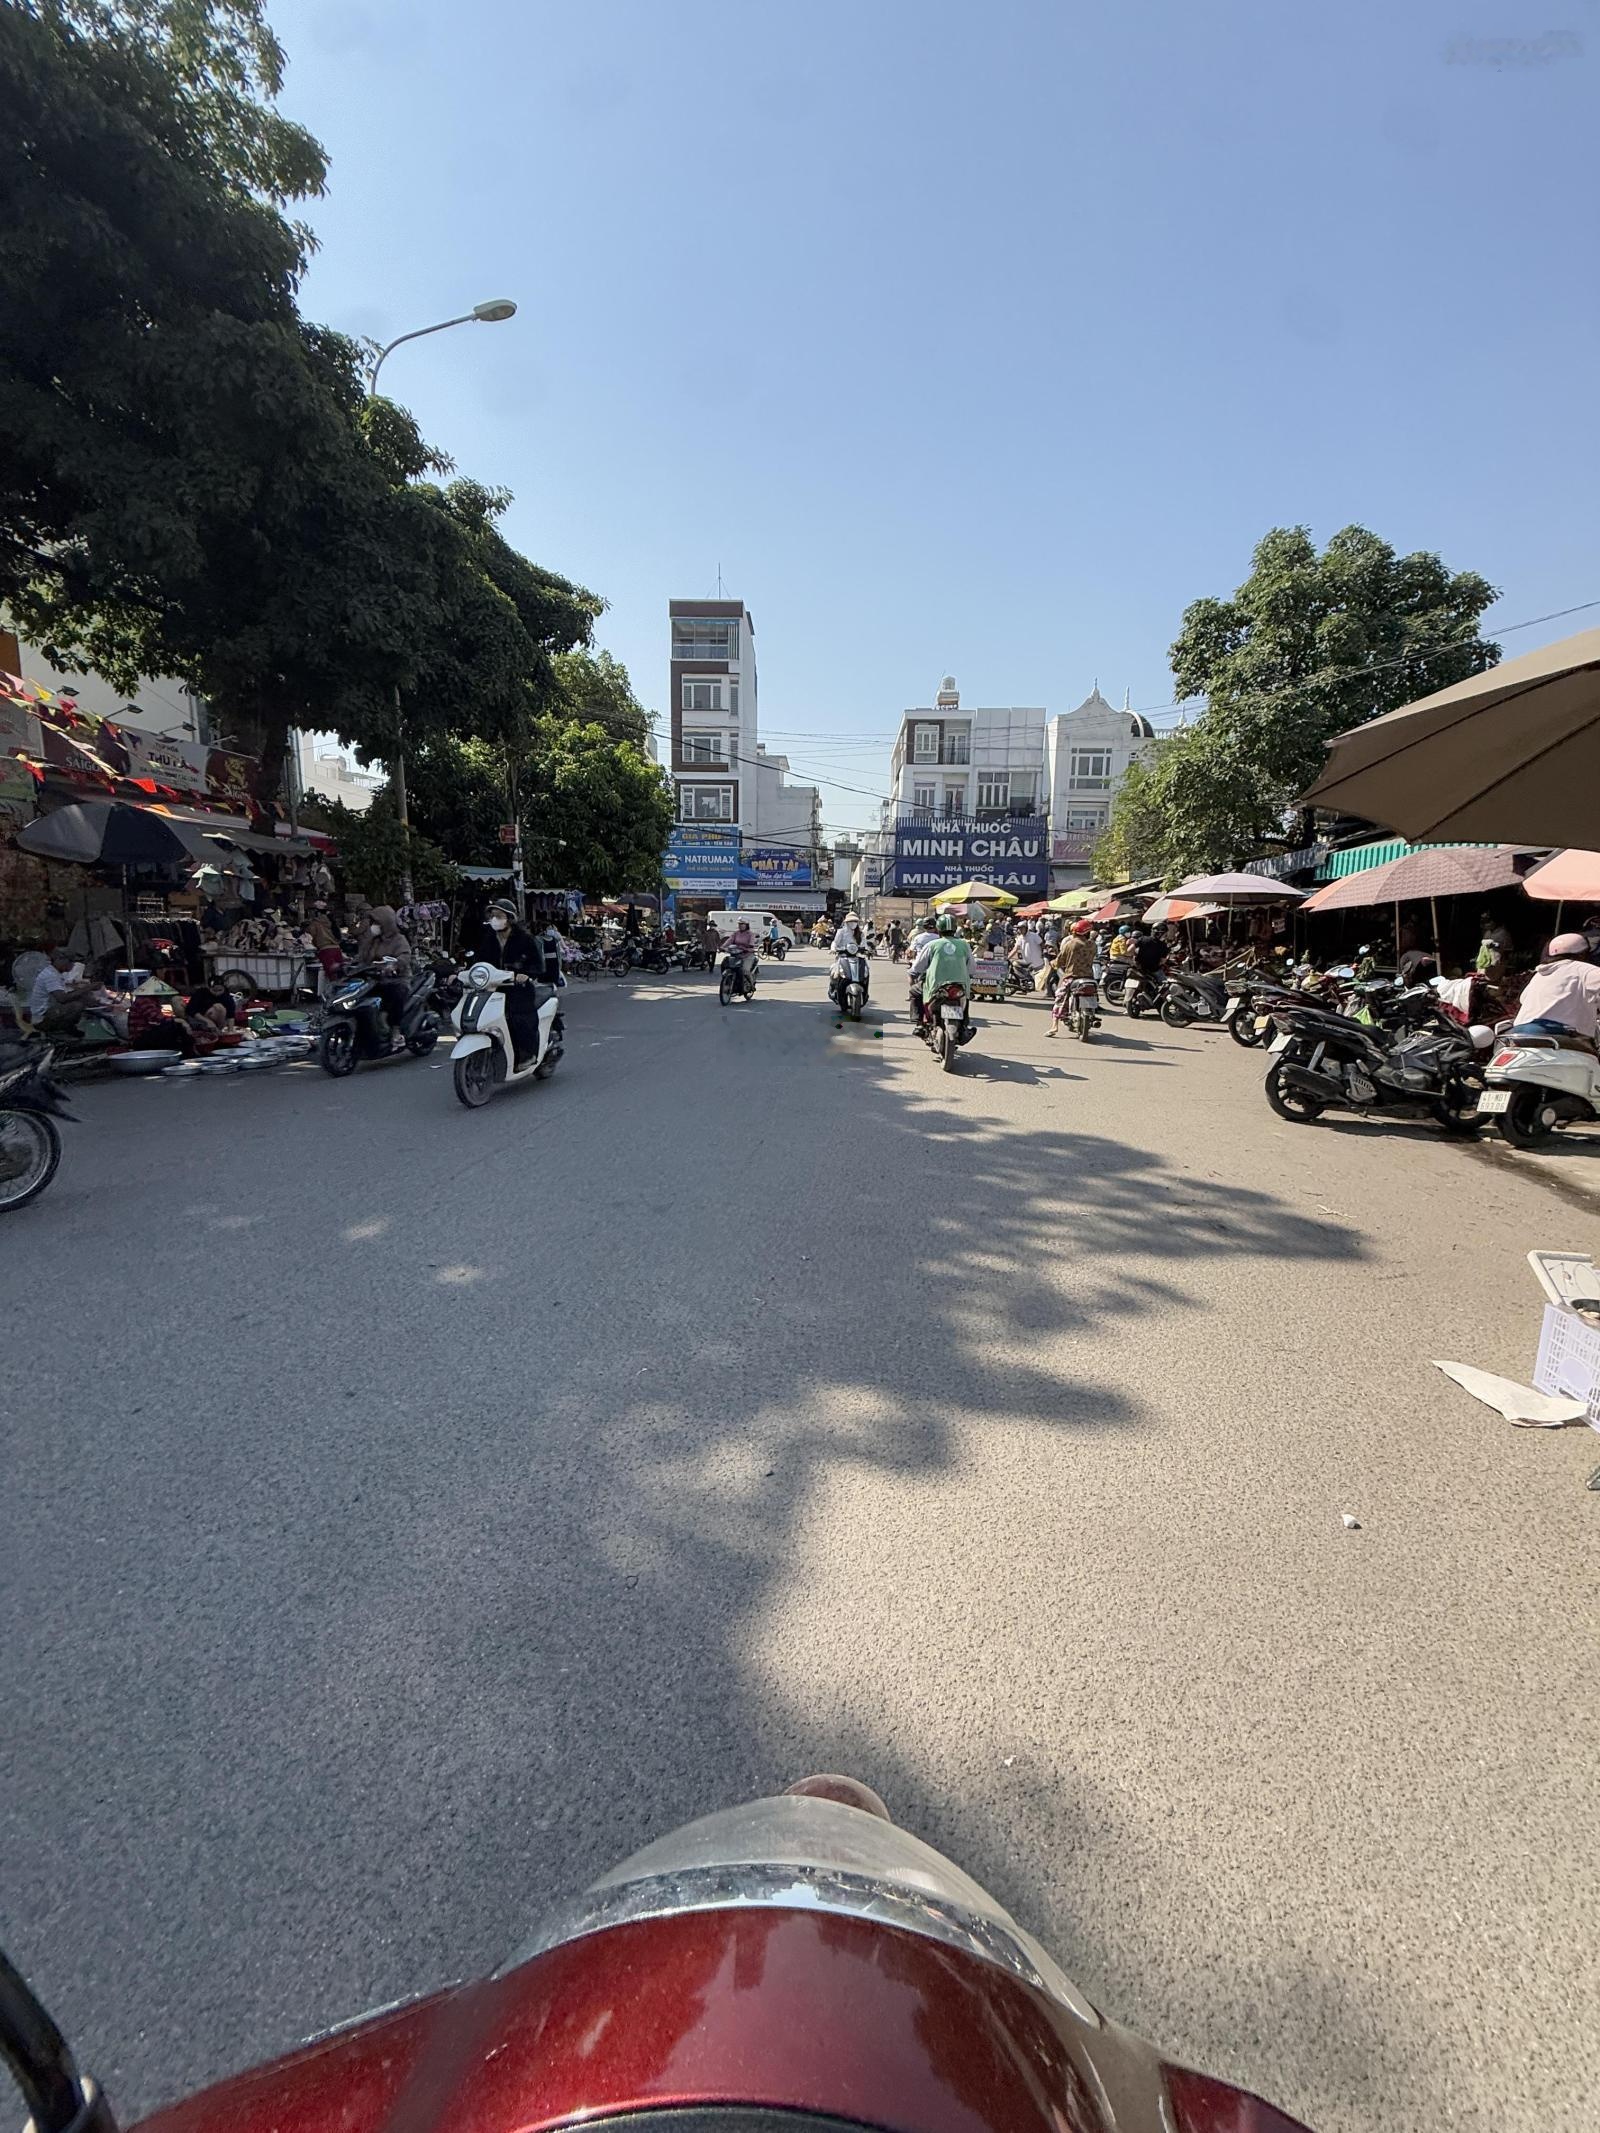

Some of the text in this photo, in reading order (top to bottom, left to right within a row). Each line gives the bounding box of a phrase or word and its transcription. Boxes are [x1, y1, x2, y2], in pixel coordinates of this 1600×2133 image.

[965, 818, 1012, 833] THUỐC
[902, 839, 963, 857] MINH
[971, 836, 1039, 857] CHÂU
[684, 855, 735, 864] NATRUMAX
[751, 859, 799, 871] PHÁT TÀI
[944, 863, 994, 872] NHÀ THUỐC
[902, 871, 1036, 885] MINH CHÂU
